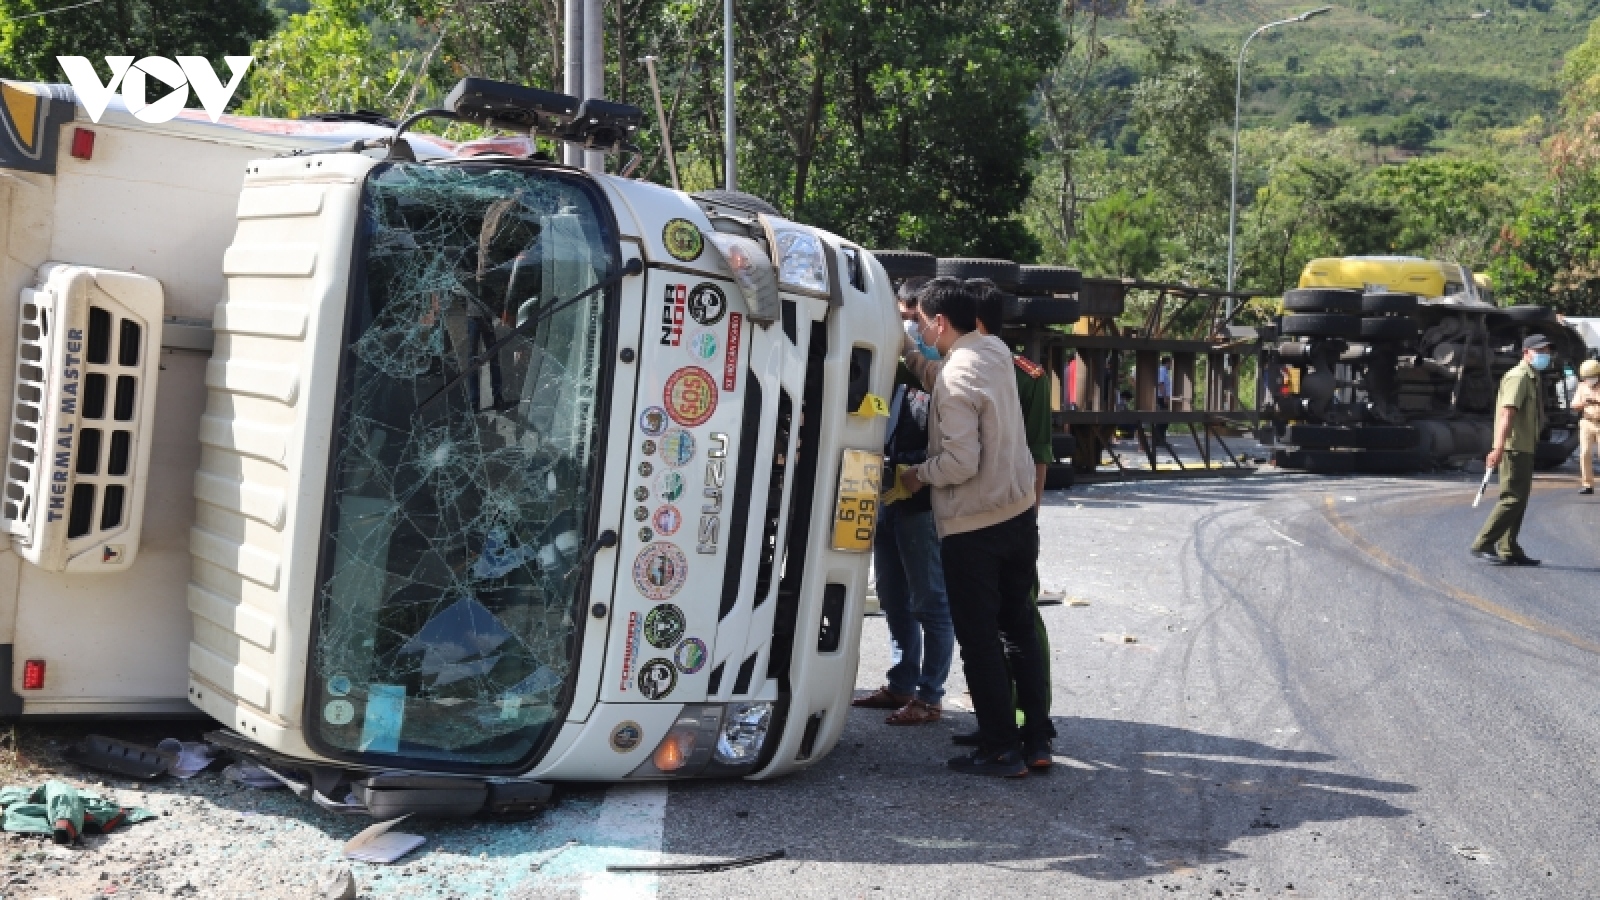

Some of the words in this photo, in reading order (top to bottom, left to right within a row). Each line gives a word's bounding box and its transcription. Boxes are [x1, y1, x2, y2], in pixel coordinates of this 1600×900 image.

[660, 284, 675, 346] NPR
[672, 284, 687, 347] 400
[60, 328, 83, 414] MASTER
[679, 379, 701, 416] SOS
[48, 423, 75, 523] THERMAL
[696, 432, 729, 555] ISUZU
[839, 478, 860, 522] 61H
[620, 611, 637, 693] FORWARD
